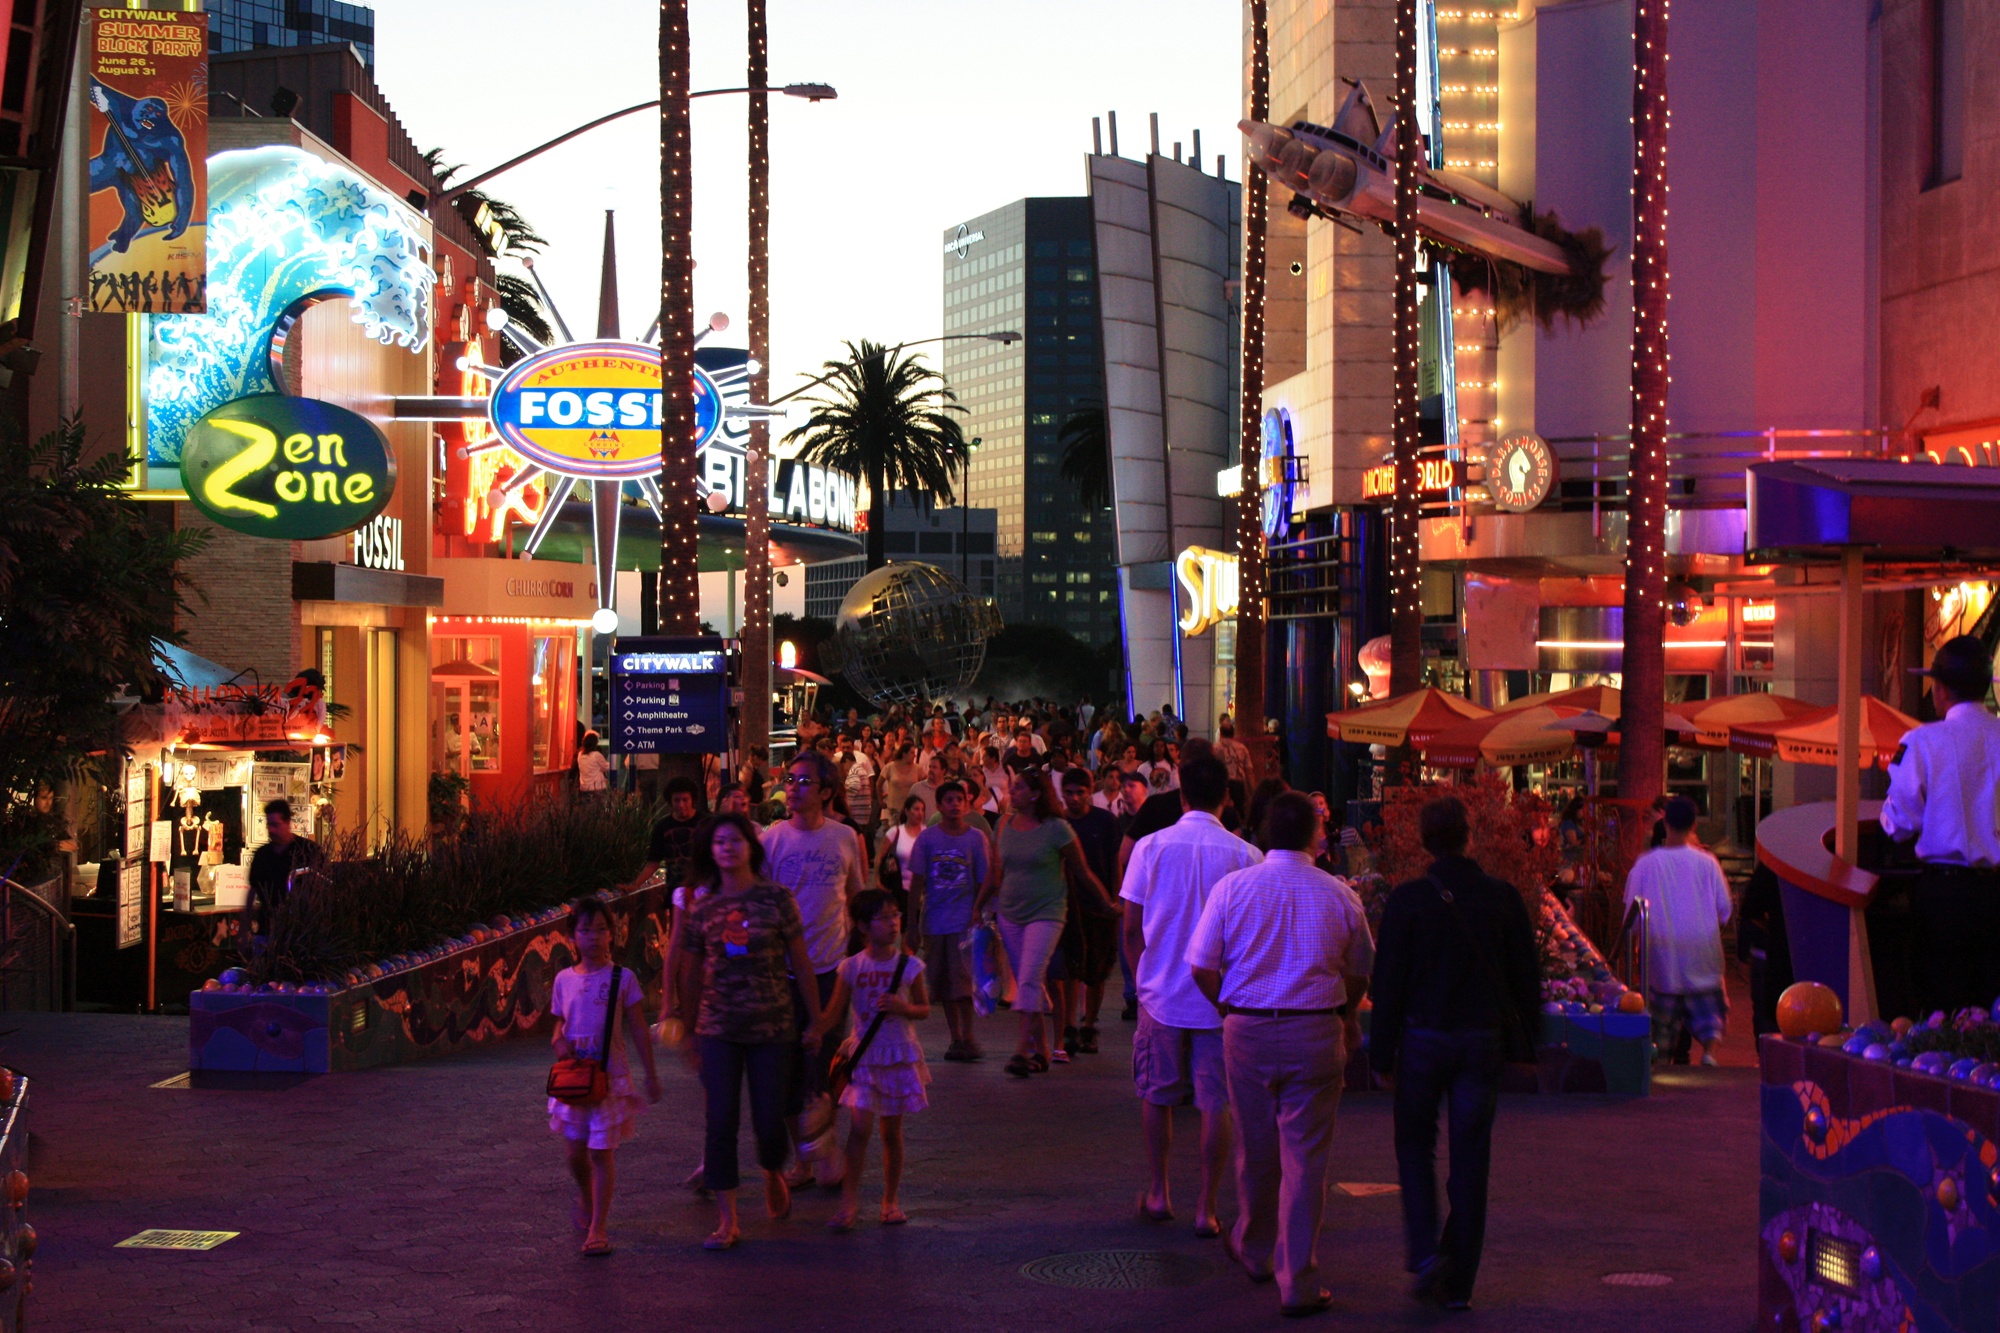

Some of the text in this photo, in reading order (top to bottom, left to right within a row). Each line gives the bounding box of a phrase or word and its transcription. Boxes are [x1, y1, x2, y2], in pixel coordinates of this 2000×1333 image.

[99, 9, 178, 21] CITYWALK
[98, 22, 201, 41] SUMMER
[98, 38, 201, 57] BLOCK PARTY
[98, 57, 127, 65] June
[130, 58, 146, 66] 26
[98, 66, 139, 75] August
[537, 360, 662, 385] AUTHENTI
[520, 391, 662, 426] FOSSI
[1417, 459, 1454, 492] ORLD
[1490, 435, 1548, 507] DARK HORSE COMICS
[704, 447, 855, 534] BILABONG
[354, 514, 405, 571] FOSSIL
[623, 658, 714, 670] CITYWALK
[635, 681, 666, 690] Parking
[636, 696, 666, 706] Parking
[637, 712, 689, 720] Amphitheatre
[637, 726, 683, 734] Theme Park
[1706, 730, 1728, 739] JODY
[637, 741, 655, 749] ATM
[1788, 745, 1813, 754] JODY
[856, 970, 893, 988] CUT
